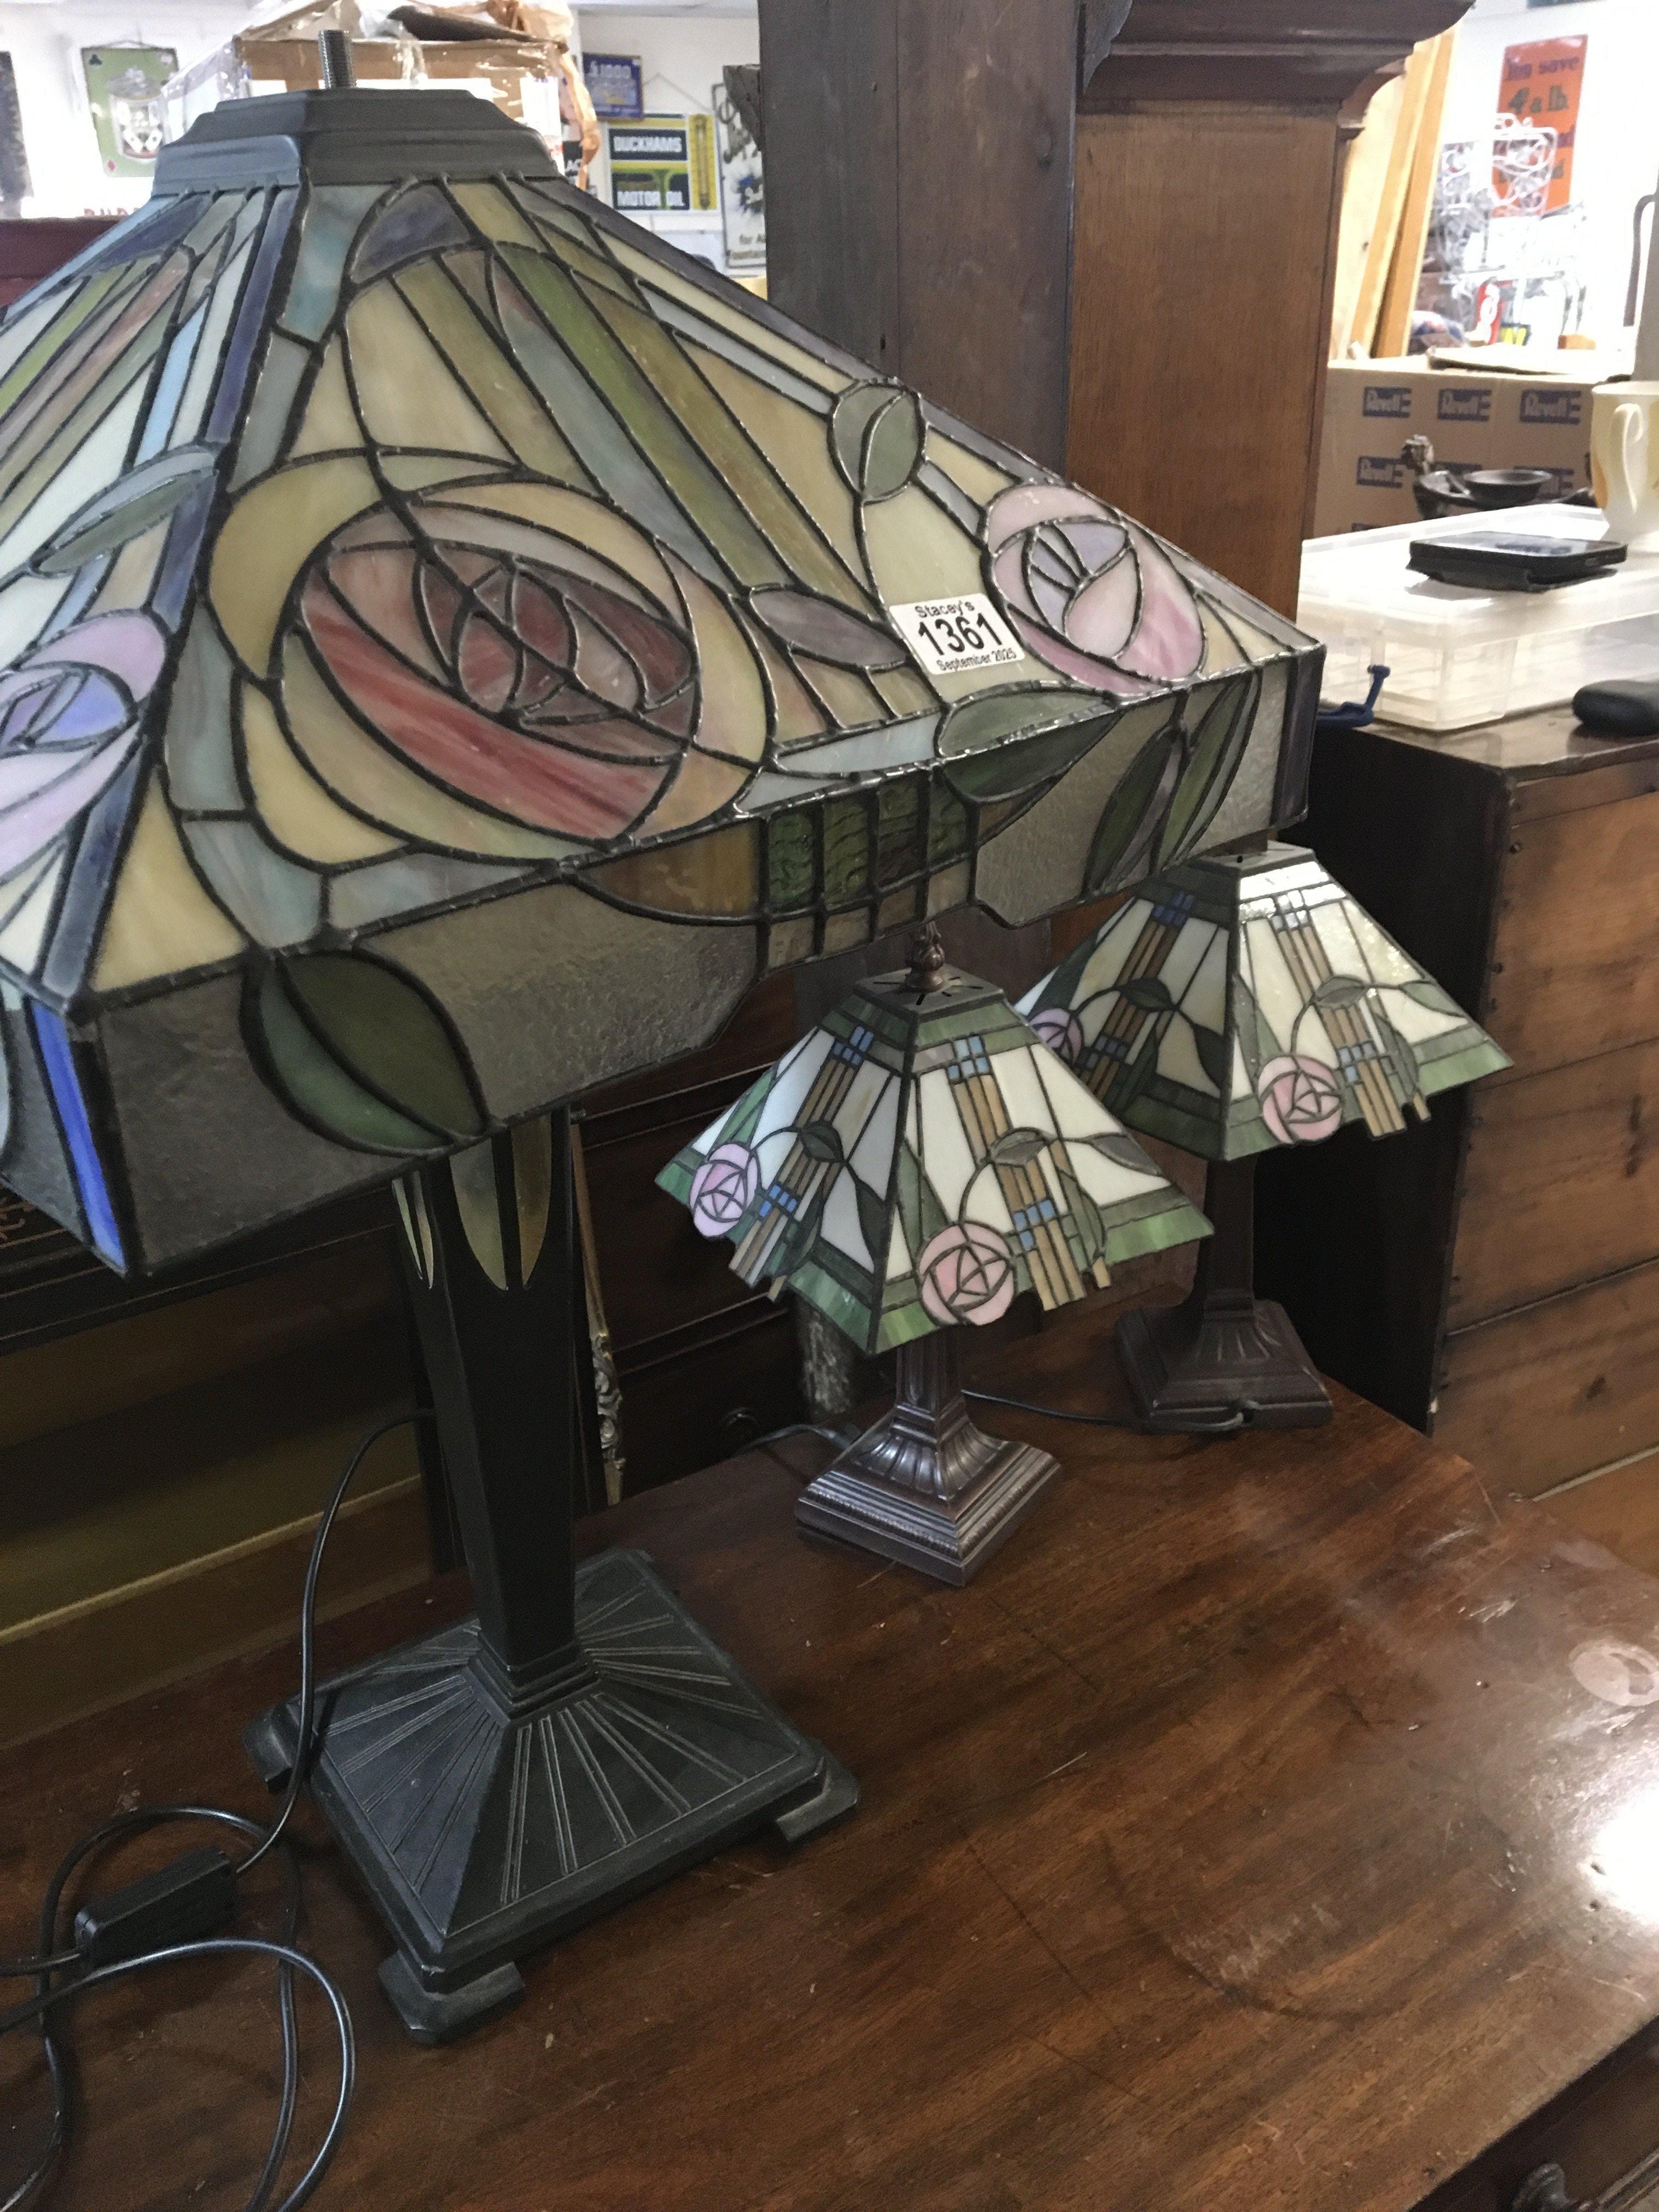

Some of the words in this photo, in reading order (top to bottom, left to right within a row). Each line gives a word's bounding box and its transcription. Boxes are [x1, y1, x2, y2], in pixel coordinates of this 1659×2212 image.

[613, 136, 682, 153] DUCKHAMS
[617, 190, 661, 206] MOTOR
[665, 190, 685, 206] OIL
[1522, 392, 1570, 419] Revell
[915, 600, 975, 618] Stacey's
[918, 613, 1002, 656] 1361
[936, 654, 990, 672] September
[991, 647, 1017, 662] 2025
